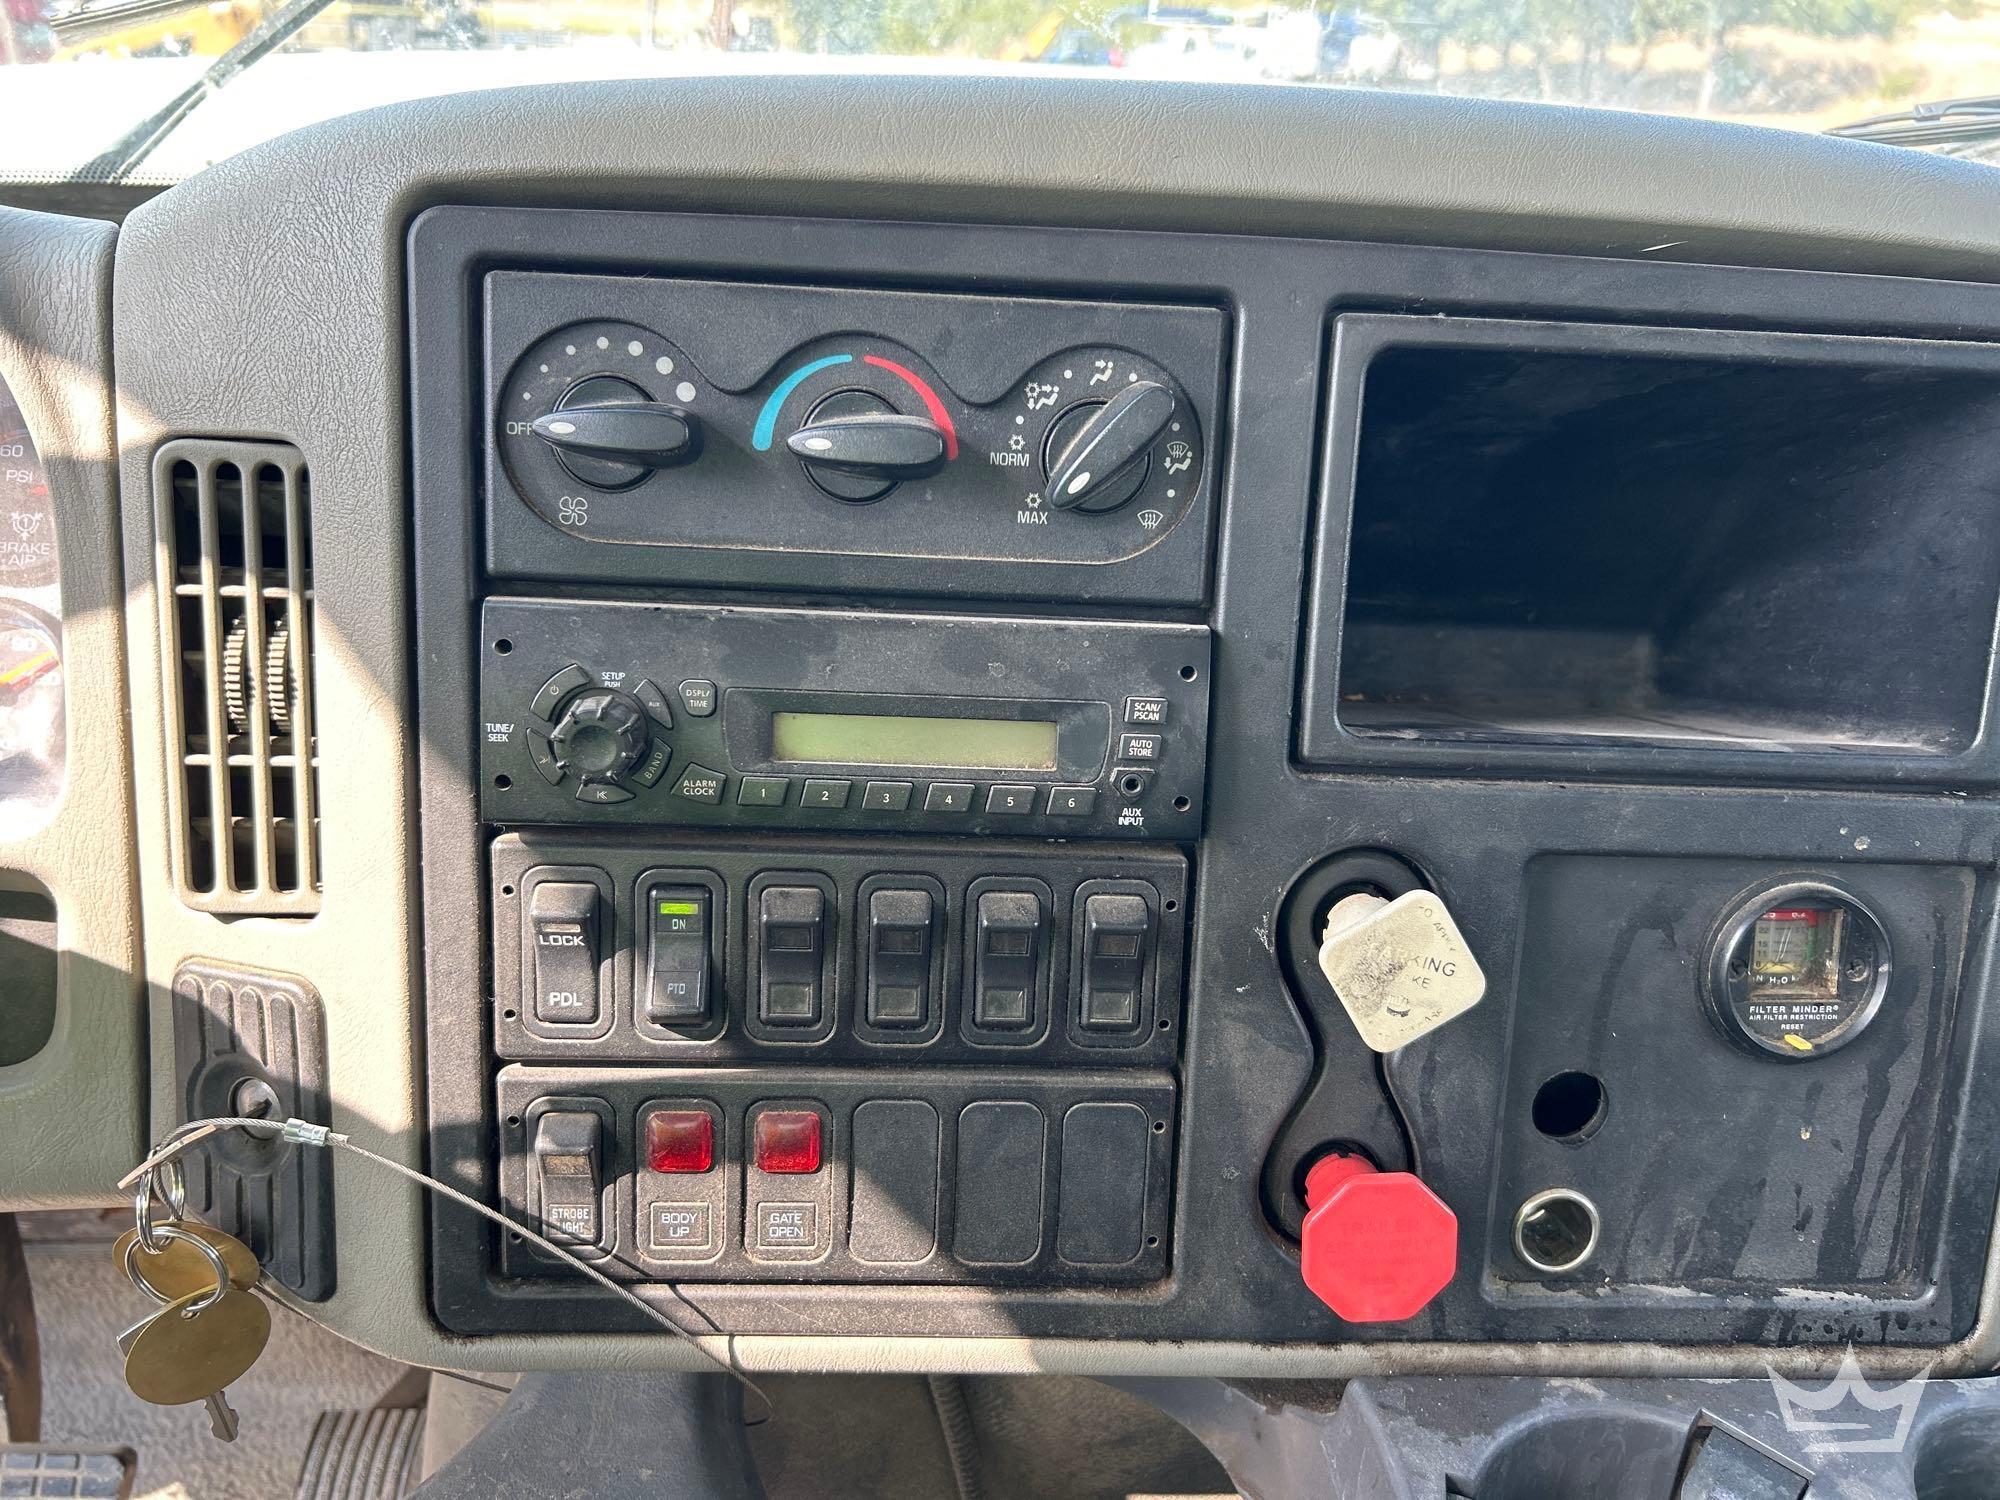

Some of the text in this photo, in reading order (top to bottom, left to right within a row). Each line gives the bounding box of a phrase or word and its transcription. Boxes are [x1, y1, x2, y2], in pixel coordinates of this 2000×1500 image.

[990, 452, 1030, 467] NORM
[6, 469, 34, 483] PSI
[1017, 511, 1049, 525] MAX
[601, 671, 626, 682] SETUP
[604, 681, 621, 689] PUSH
[685, 688, 710, 698] DSPL/
[689, 699, 709, 709] TIME
[1134, 702, 1161, 712] SCAN/
[1133, 711, 1160, 721] PSCAN
[485, 722, 515, 734] TUNE/
[487, 732, 509, 743] SEEK
[1129, 739, 1153, 749] AUTO
[1128, 748, 1153, 757] STORE
[643, 752, 664, 780] BAND
[682, 778, 717, 789] ALARM
[682, 786, 716, 797] CLOCK
[760, 788, 767, 798] 1
[821, 790, 829, 801] 2
[883, 792, 891, 804] 3
[944, 794, 953, 806] 4
[1006, 796, 1015, 807] 5
[1067, 797, 1076, 809] 6
[1121, 807, 1142, 817] AUX
[1118, 816, 1144, 826] INPUT
[671, 918, 687, 930] ON
[539, 934, 585, 947] LOCK
[667, 982, 687, 995] PTO
[549, 991, 583, 1007] PDL
[1749, 1005, 1786, 1014] FILTER
[552, 1208, 590, 1220] STROBE
[661, 1212, 698, 1225] BODY
[769, 1212, 803, 1225] GATE
[562, 1220, 585, 1234] IGHT
[669, 1226, 690, 1237] UP
[769, 1226, 804, 1238] OPEN
